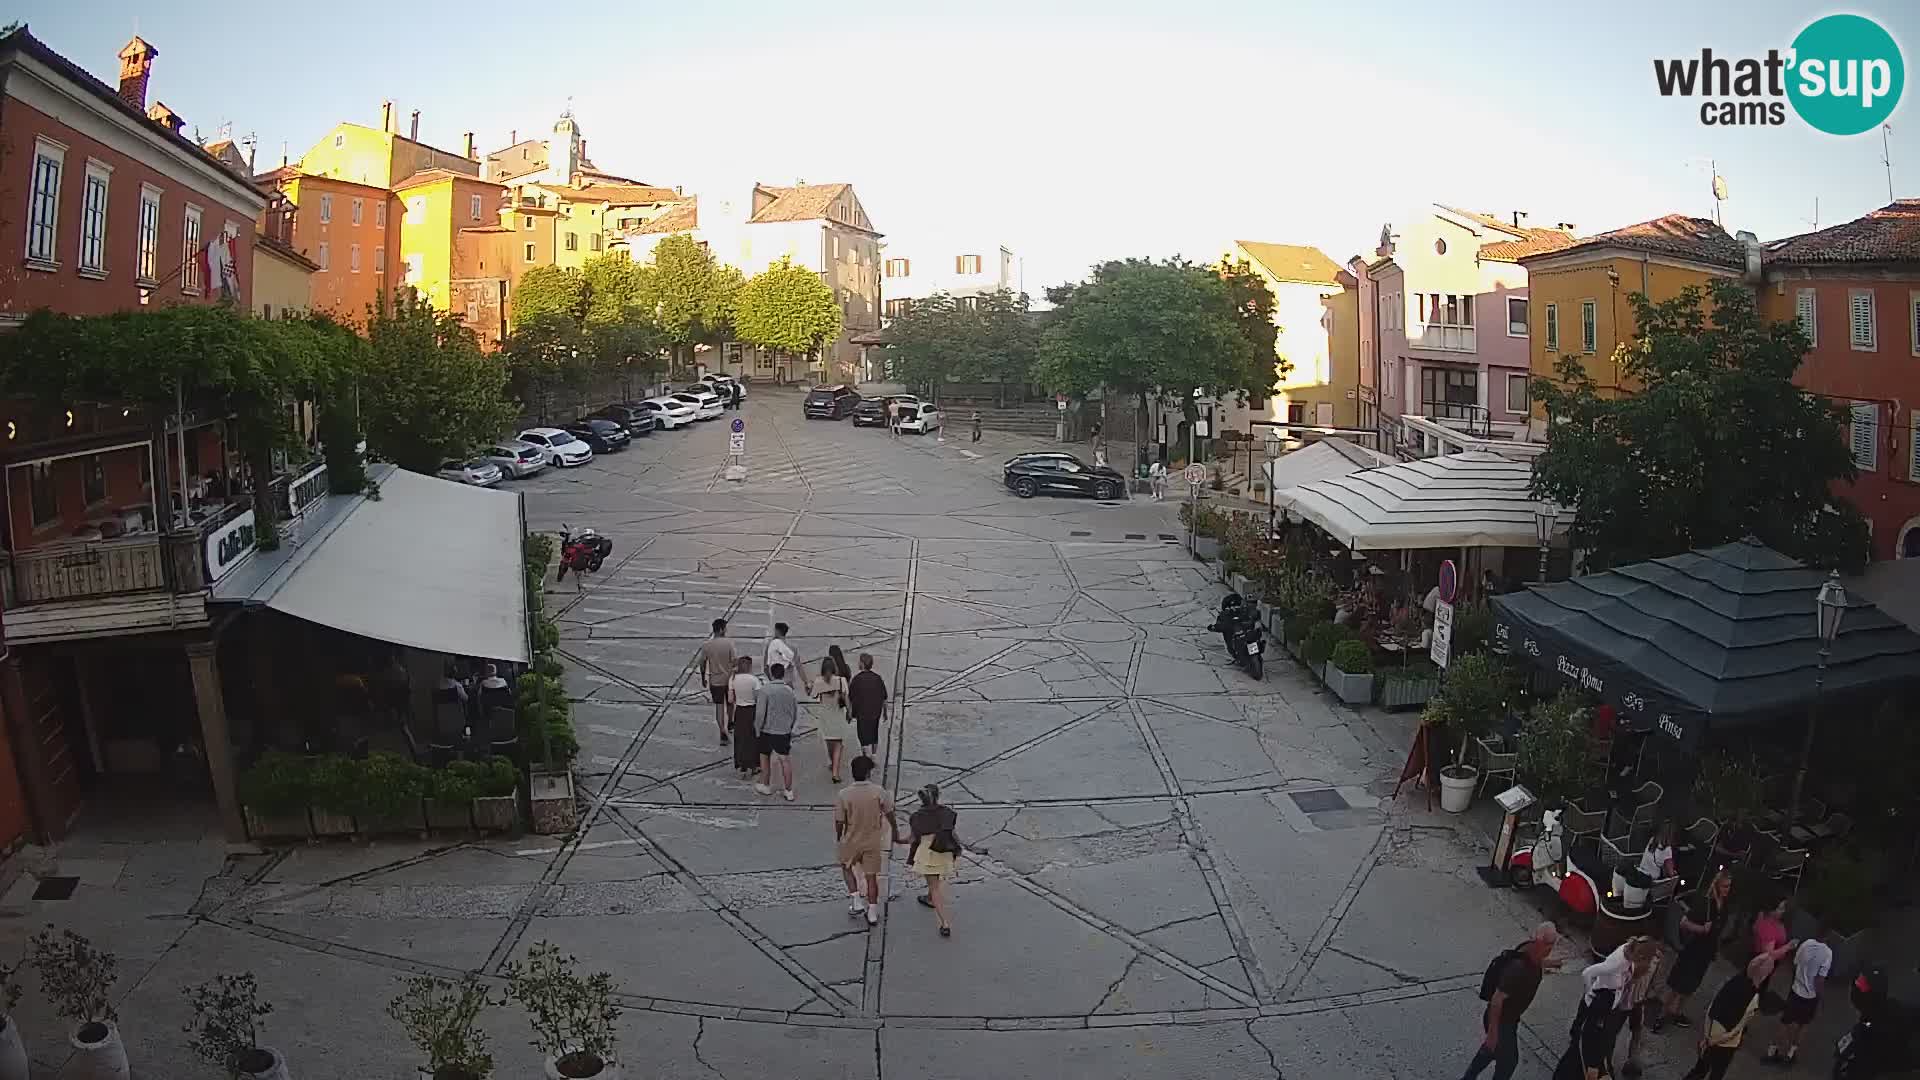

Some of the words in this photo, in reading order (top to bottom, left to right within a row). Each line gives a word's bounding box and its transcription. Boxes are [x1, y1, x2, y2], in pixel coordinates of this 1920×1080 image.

[1557, 655, 1580, 679] Pizza
[1580, 667, 1604, 692] Roma
[1659, 713, 1683, 740] Pinsa
